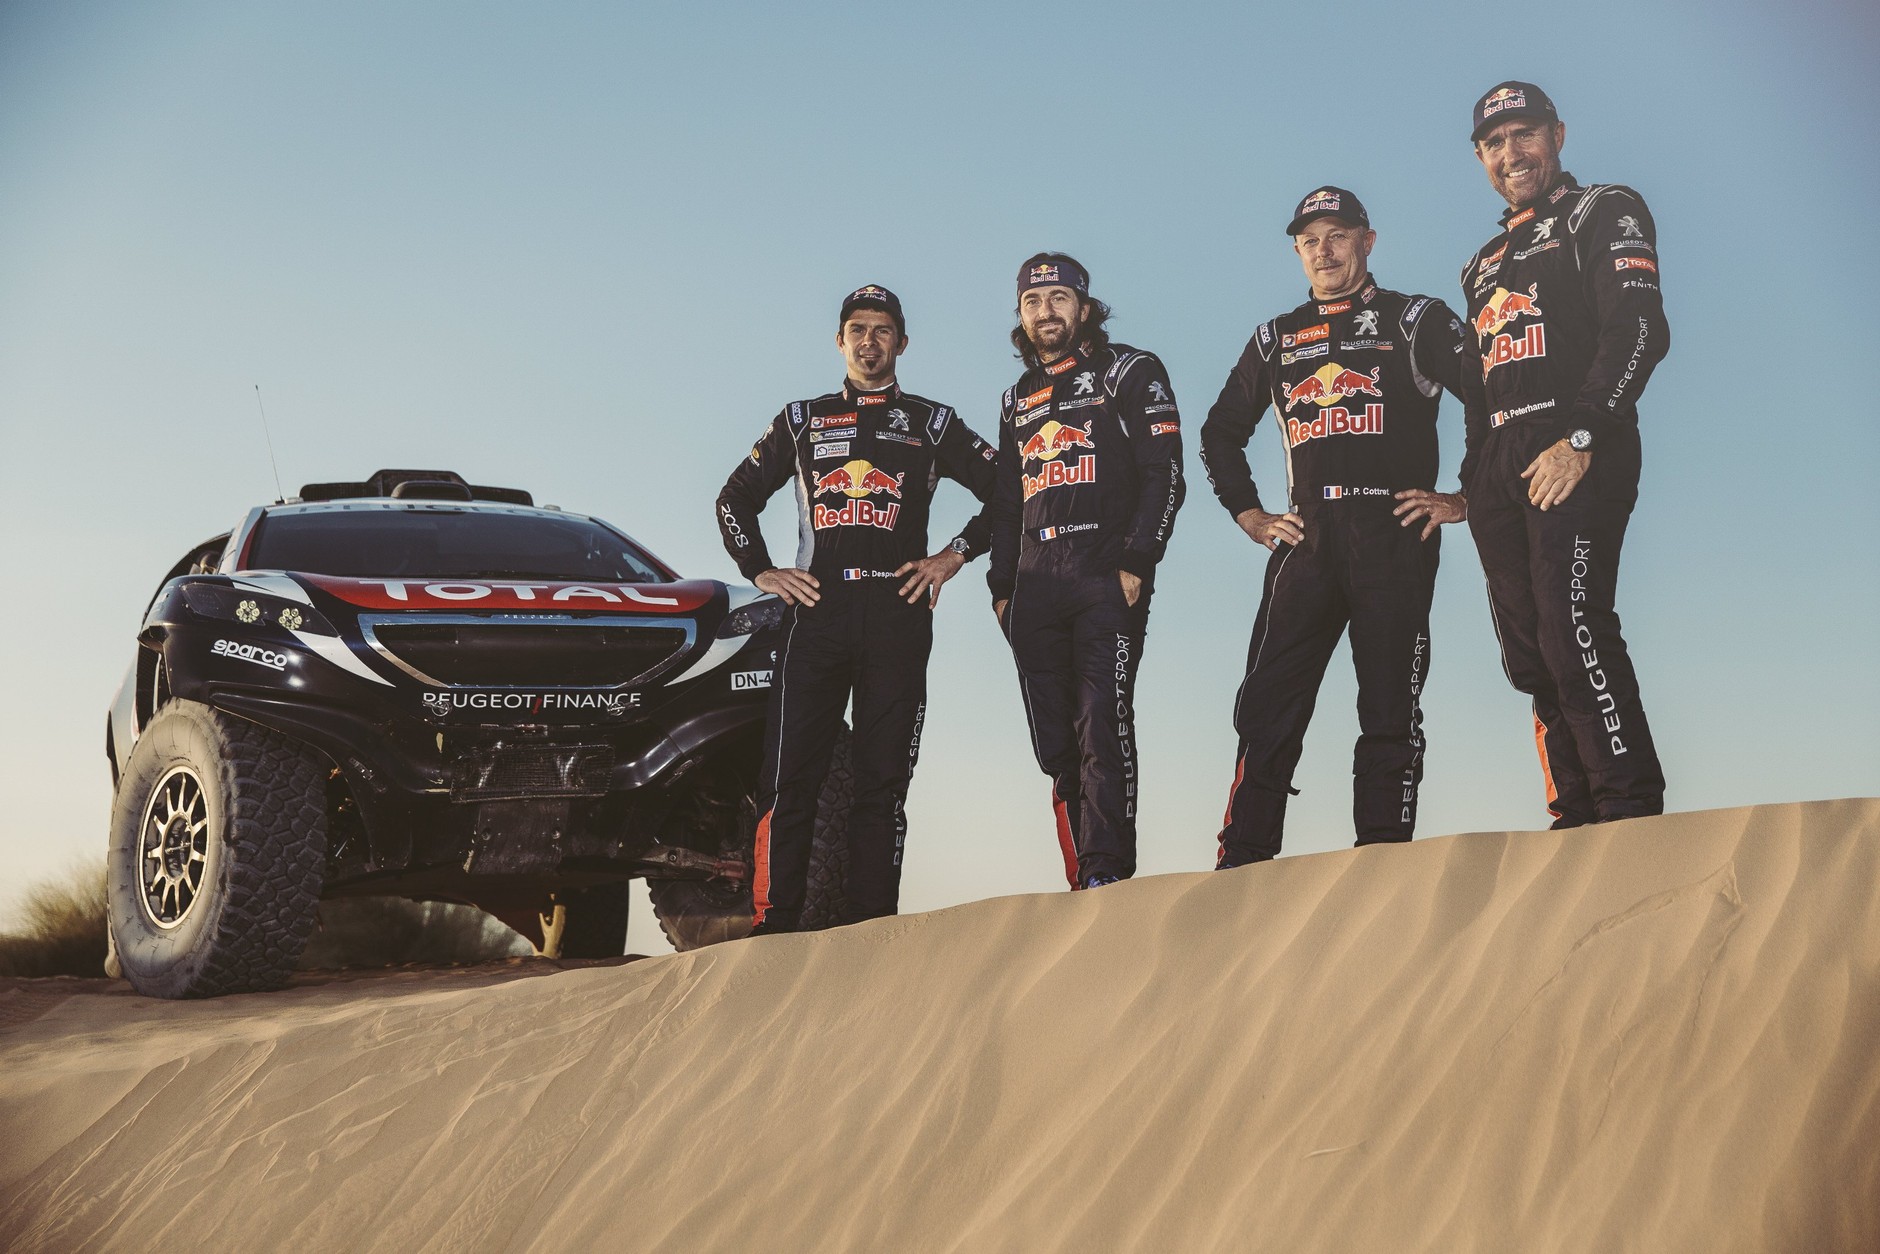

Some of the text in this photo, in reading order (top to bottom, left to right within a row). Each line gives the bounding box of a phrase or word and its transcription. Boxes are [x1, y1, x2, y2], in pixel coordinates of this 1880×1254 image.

[1483, 98, 1526, 118] Red Bull
[1302, 201, 1340, 215] Red Bull
[1512, 212, 1534, 224] TOTAL
[1629, 259, 1656, 271] TOTAL
[1030, 273, 1060, 284] Red Bull
[1622, 280, 1658, 290] ZENITH
[1327, 303, 1351, 312] TOTAL
[1296, 328, 1328, 342] TOTAL
[1494, 322, 1546, 365] Bull
[1295, 345, 1327, 358] MICHELIN
[1053, 360, 1076, 373] TOTAL
[1608, 316, 1649, 408] EUGEOT SPORT
[865, 395, 887, 404] TOTAL
[1029, 391, 1052, 404] TOTAL
[1059, 398, 1091, 406] PEUGEOT
[1510, 398, 1555, 418] Peterhansel
[825, 416, 855, 425] TOTAL
[933, 407, 948, 431] sparco
[1287, 403, 1384, 448] Red Bull
[824, 429, 855, 438] MICHELIN
[876, 430, 907, 439] PEUGEOT
[1021, 454, 1096, 503] Red Bull
[1343, 487, 1390, 495] J. P. Cottret
[814, 499, 901, 531] Red Bull
[1059, 522, 1099, 534] D.Castera
[358, 579, 679, 605] TOTAL
[1571, 535, 1628, 756] PEUGEOT SPORT
[212, 638, 288, 670] sparco
[1411, 632, 1428, 695] SPORT
[422, 692, 642, 709] PEUGEOT FINANCE
[909, 702, 926, 757] SPORT
[1115, 632, 1135, 818] PEUGEOT SPORT
